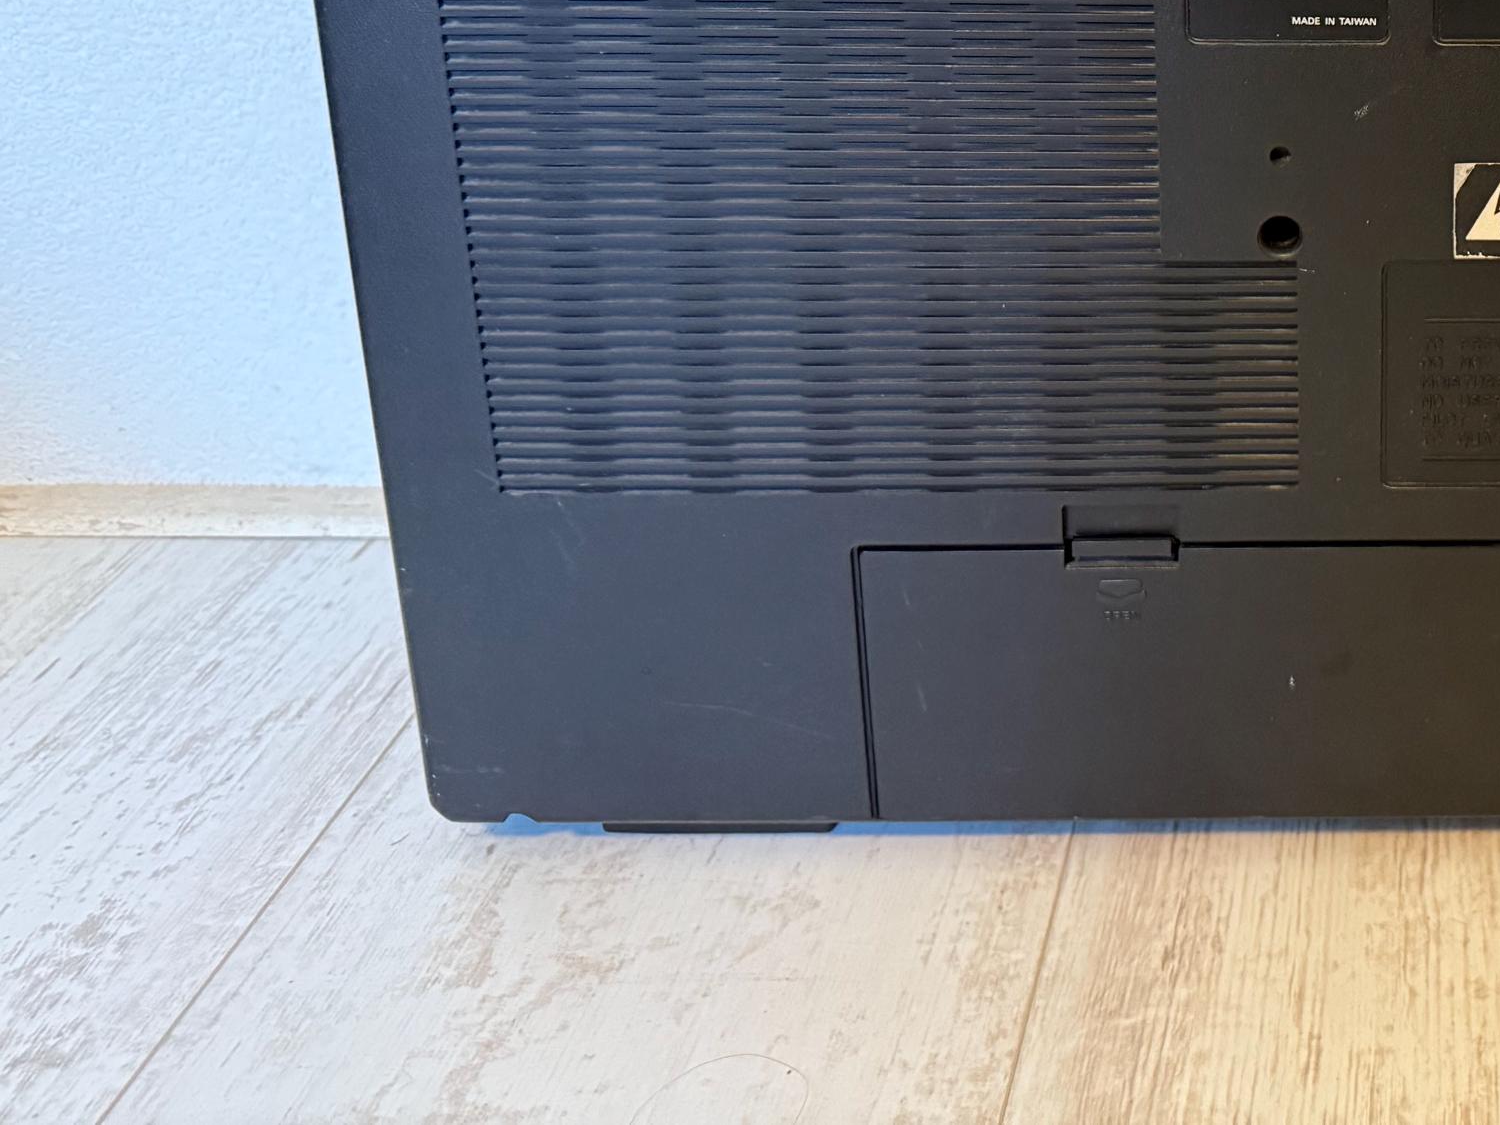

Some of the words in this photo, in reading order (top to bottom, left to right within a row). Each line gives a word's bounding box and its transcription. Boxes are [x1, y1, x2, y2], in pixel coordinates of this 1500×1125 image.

[1292, 17, 1321, 25] MADE
[1325, 17, 1335, 26] IN
[1338, 17, 1377, 26] TAIWAN
